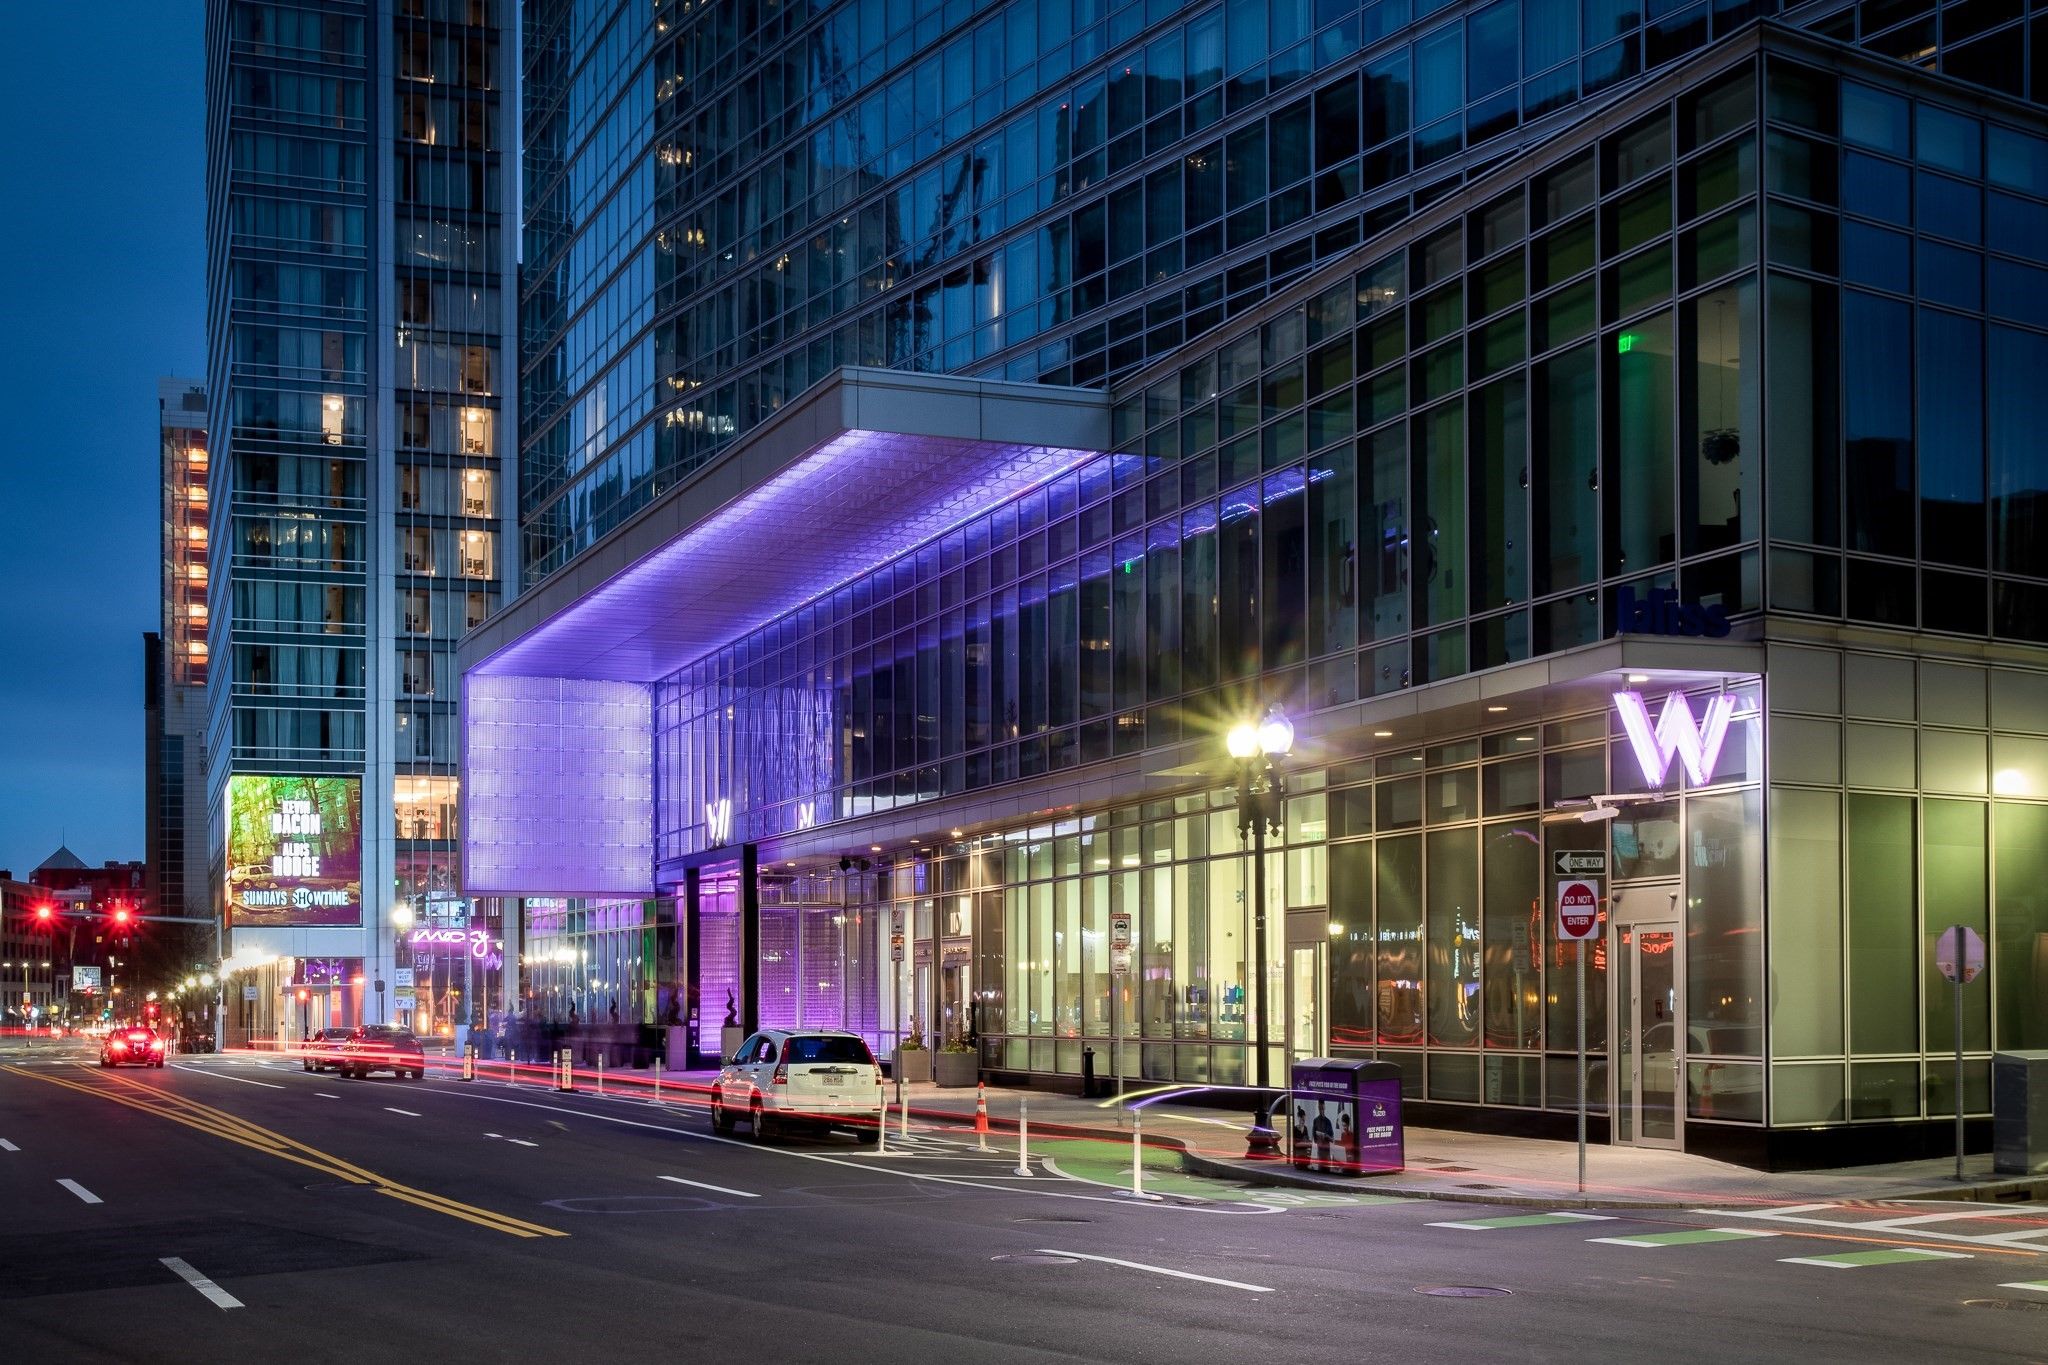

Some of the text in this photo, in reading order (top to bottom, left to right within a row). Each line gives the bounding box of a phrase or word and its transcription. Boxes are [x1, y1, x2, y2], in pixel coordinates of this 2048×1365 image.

[1612, 689, 1736, 789] W
[282, 800, 311, 814] KEVIN
[272, 814, 320, 835] BACON
[283, 842, 310, 857] ALDIS
[273, 856, 320, 877] HODGE
[1569, 858, 1600, 868] ONE WAY
[242, 887, 349, 909] SUNDAYS SHOWTIME
[1564, 895, 1592, 904] DO NOT
[1567, 916, 1589, 925] ENTER
